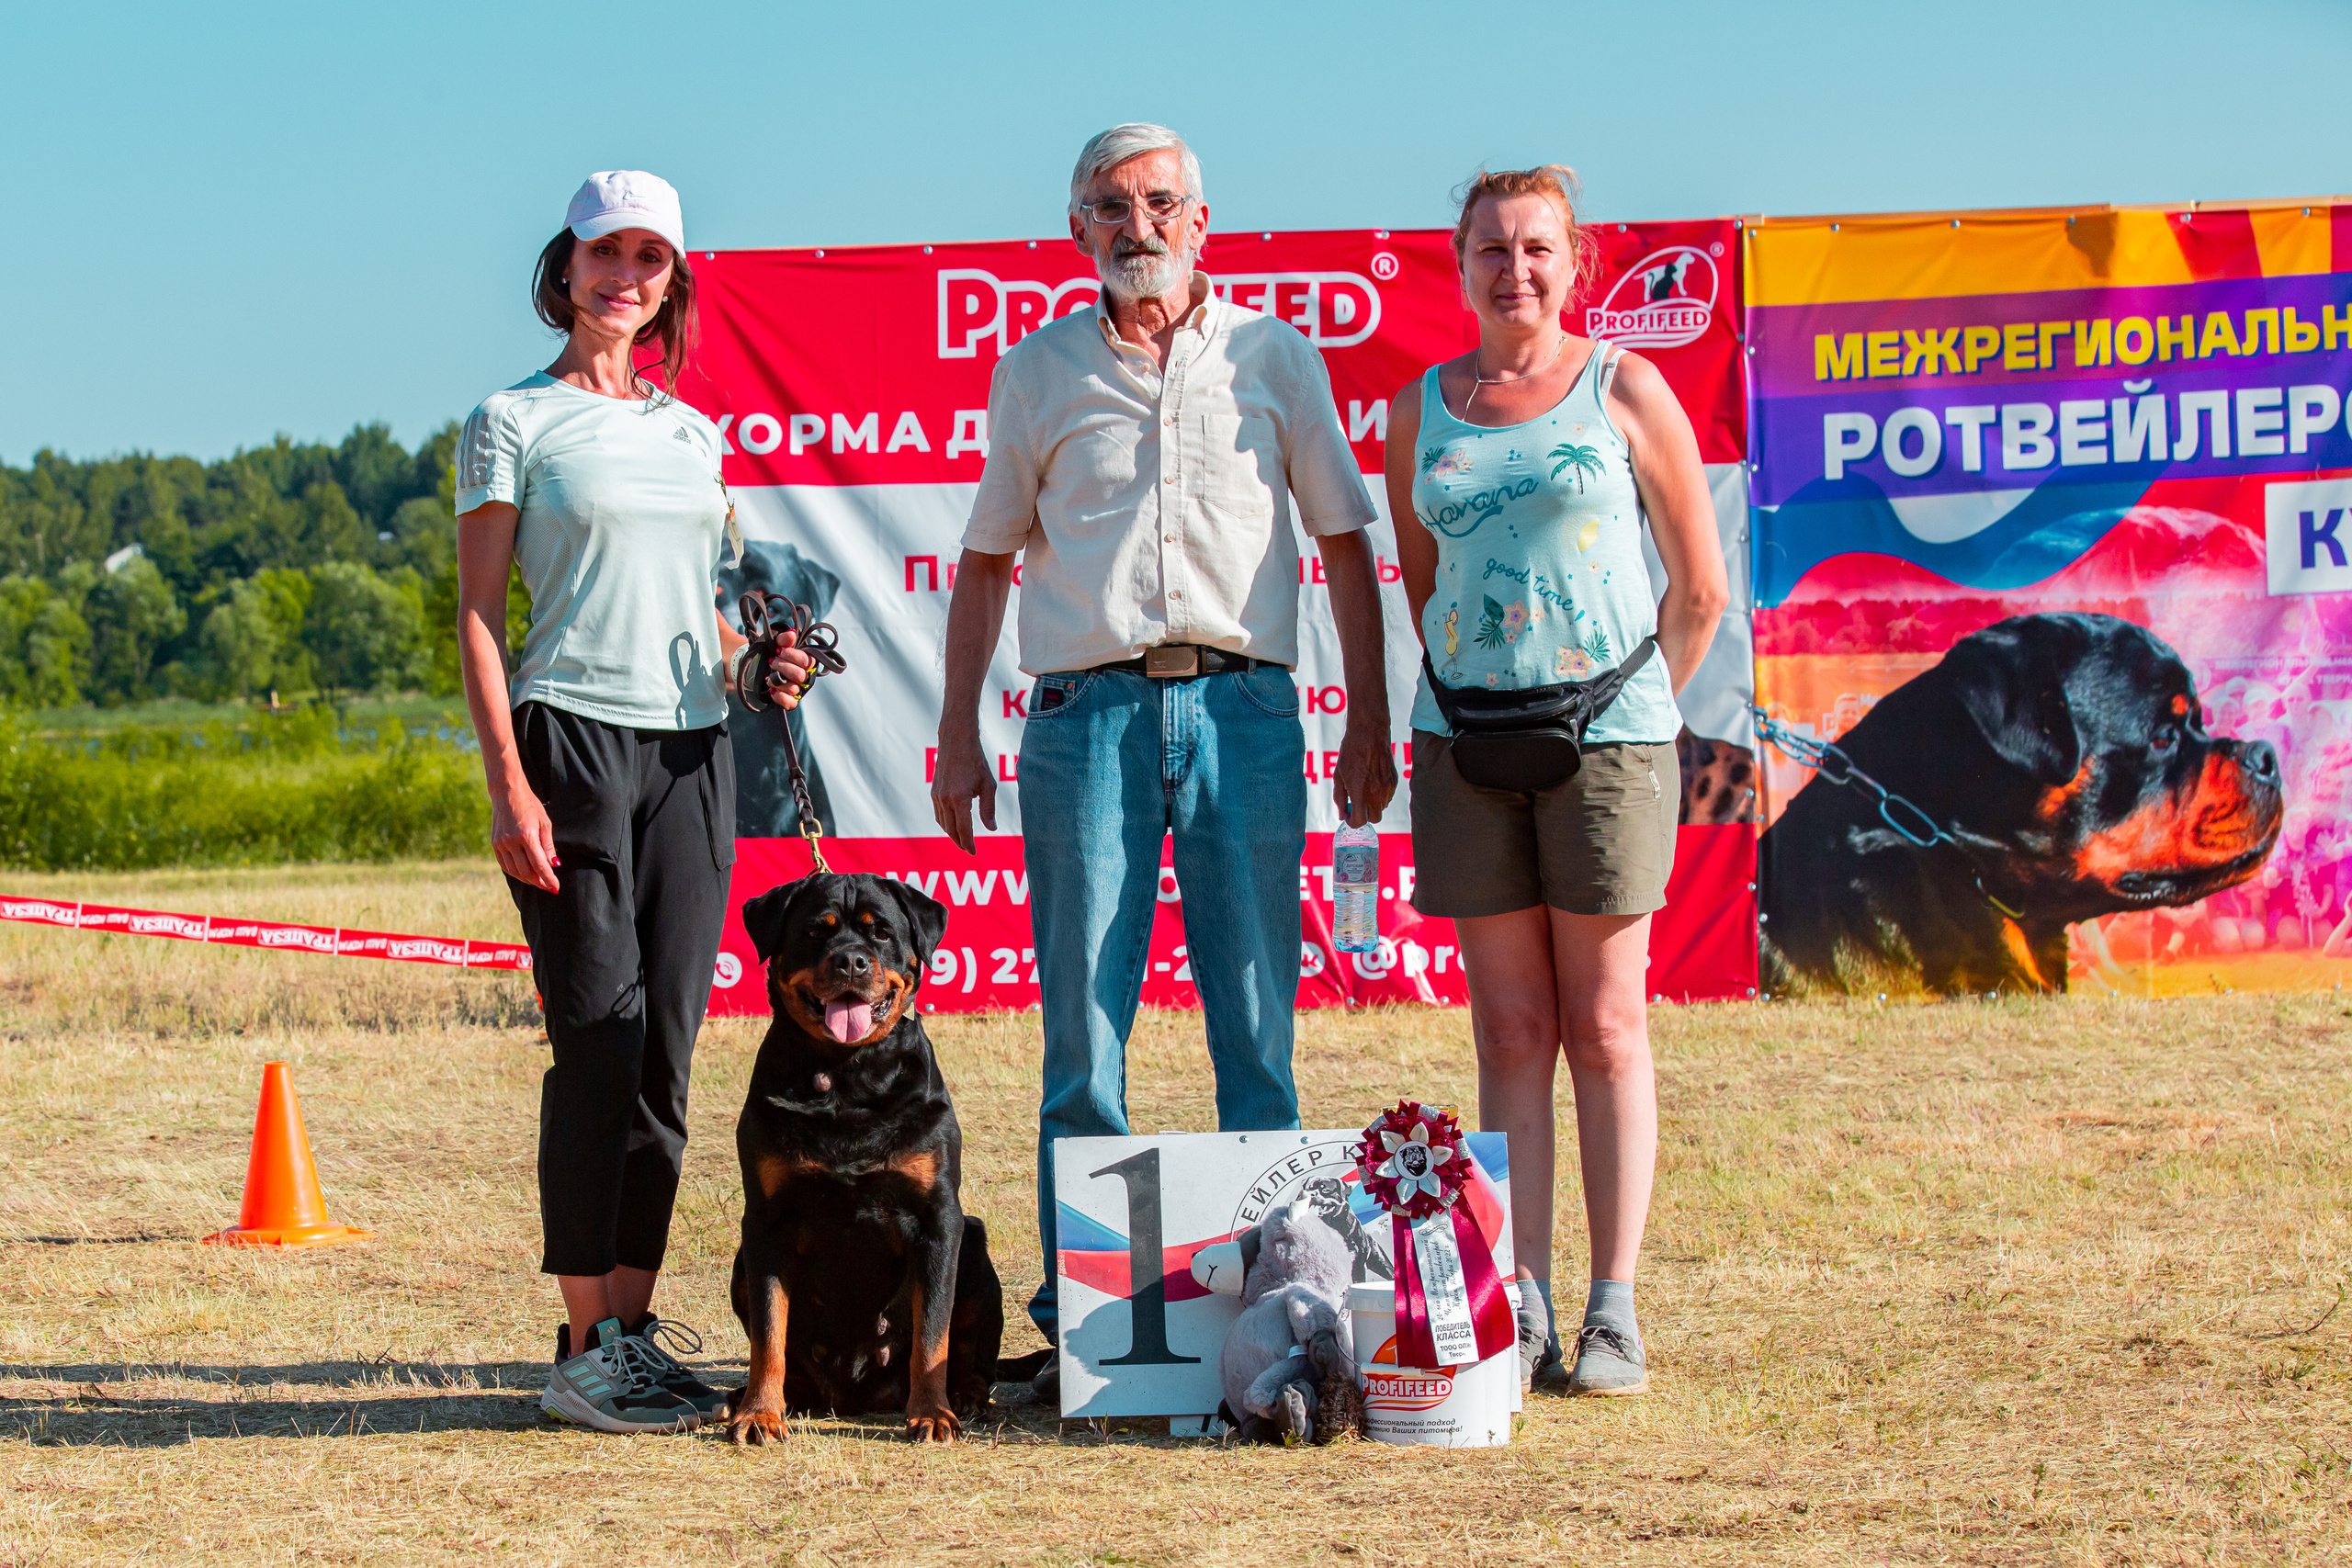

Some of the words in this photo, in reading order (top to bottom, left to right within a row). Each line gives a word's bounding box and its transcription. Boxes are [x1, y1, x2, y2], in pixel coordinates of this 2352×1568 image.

[1587, 309, 1710, 333] PROFIFEED
[1823, 378, 2352, 480] РОТВЕЙЛЕР
[1416, 478, 1539, 538] Havana
[2299, 506, 2352, 570] К
[1483, 558, 1531, 584] good
[4, 904, 74, 922] ТРАПЕЗА
[131, 917, 202, 935] ТРАПЕЗА
[261, 930, 333, 948] ТРАПЕЗА
[390, 942, 461, 960] ТРАПЕЗА
[1089, 1147, 1201, 1366] 1
[1436, 1322, 1471, 1332] ПОБЕДИТЕЛЬ
[1436, 1330, 1471, 1341] КЛАССА
[1362, 1374, 1452, 1396] PROFIFEED
[1392, 1426, 1416, 1434] Ваших
[1426, 1417, 1456, 1427] подход
